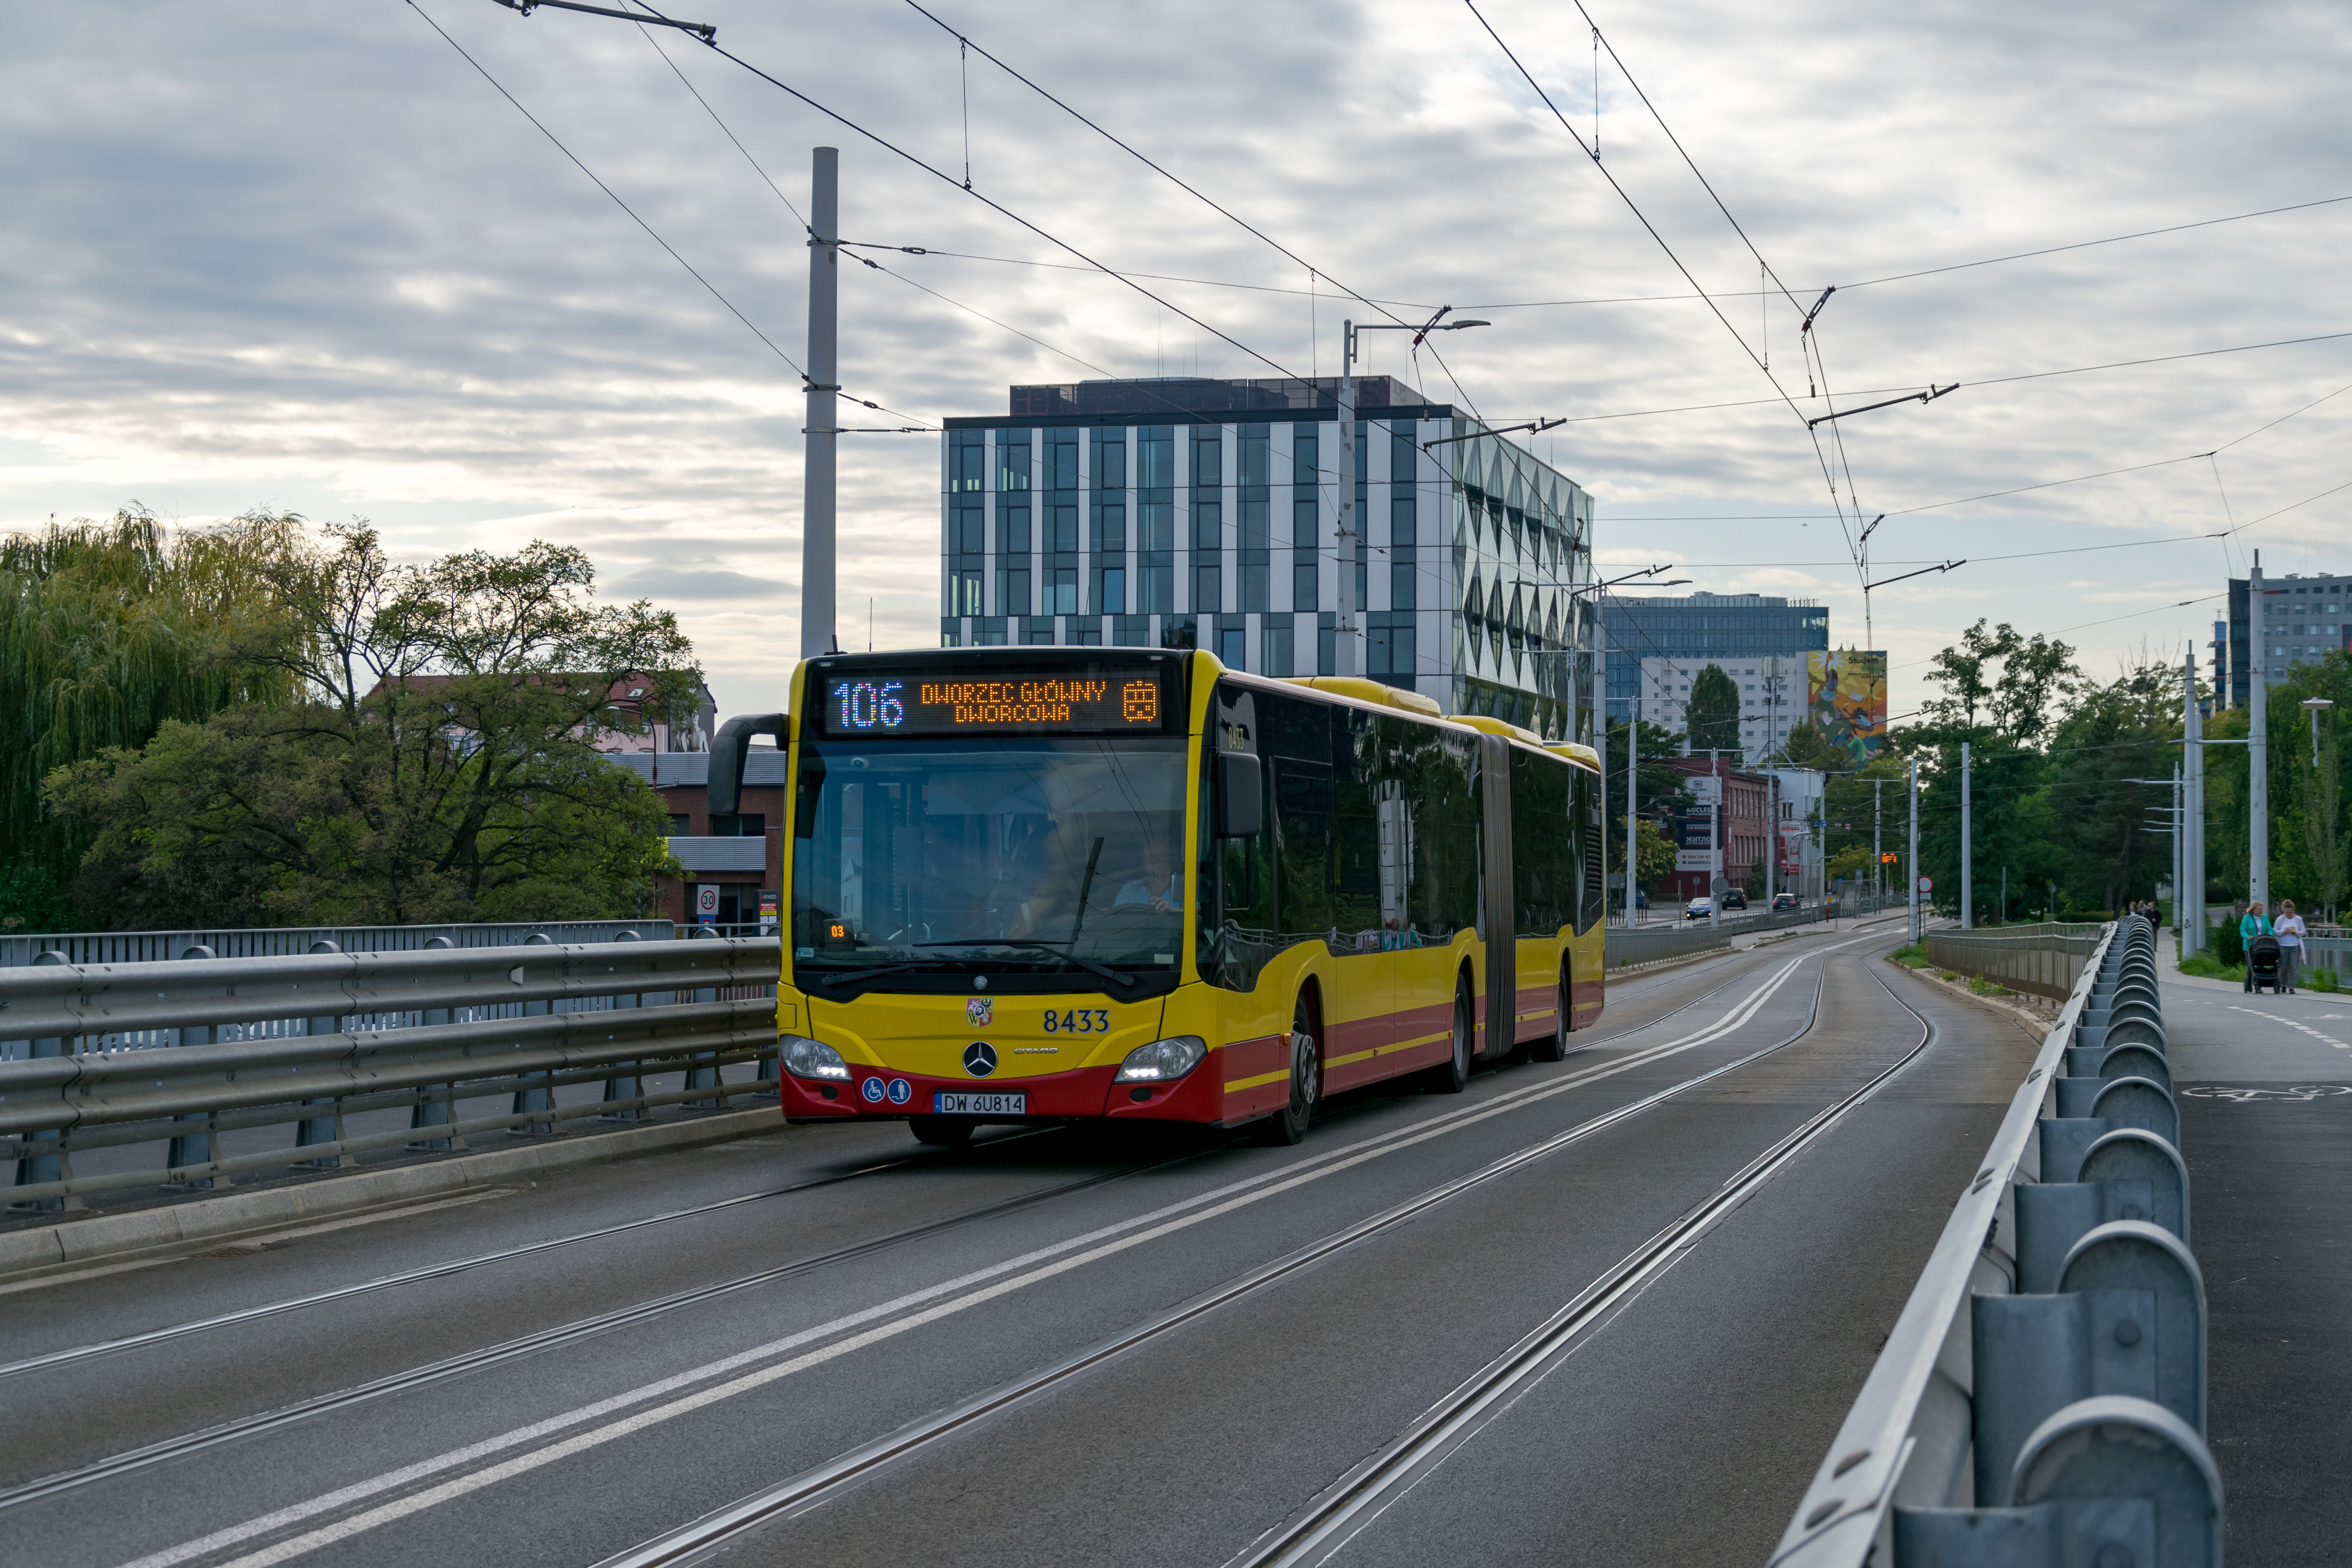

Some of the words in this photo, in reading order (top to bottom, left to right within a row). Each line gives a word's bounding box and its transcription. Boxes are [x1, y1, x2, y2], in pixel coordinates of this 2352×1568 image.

[1848, 656, 1879, 664] Student
[922, 682, 1013, 704] DWORZEC
[1021, 679, 1105, 702] GŁÓWNY
[835, 682, 902, 726] 106
[955, 704, 1069, 722] DWORCOWA
[1228, 726, 1244, 750] 8433
[703, 895, 714, 905] 30
[831, 925, 844, 937] 03
[1043, 1009, 1111, 1034] 8433
[945, 1095, 967, 1111] DW
[973, 1096, 1022, 1112] 6U814
